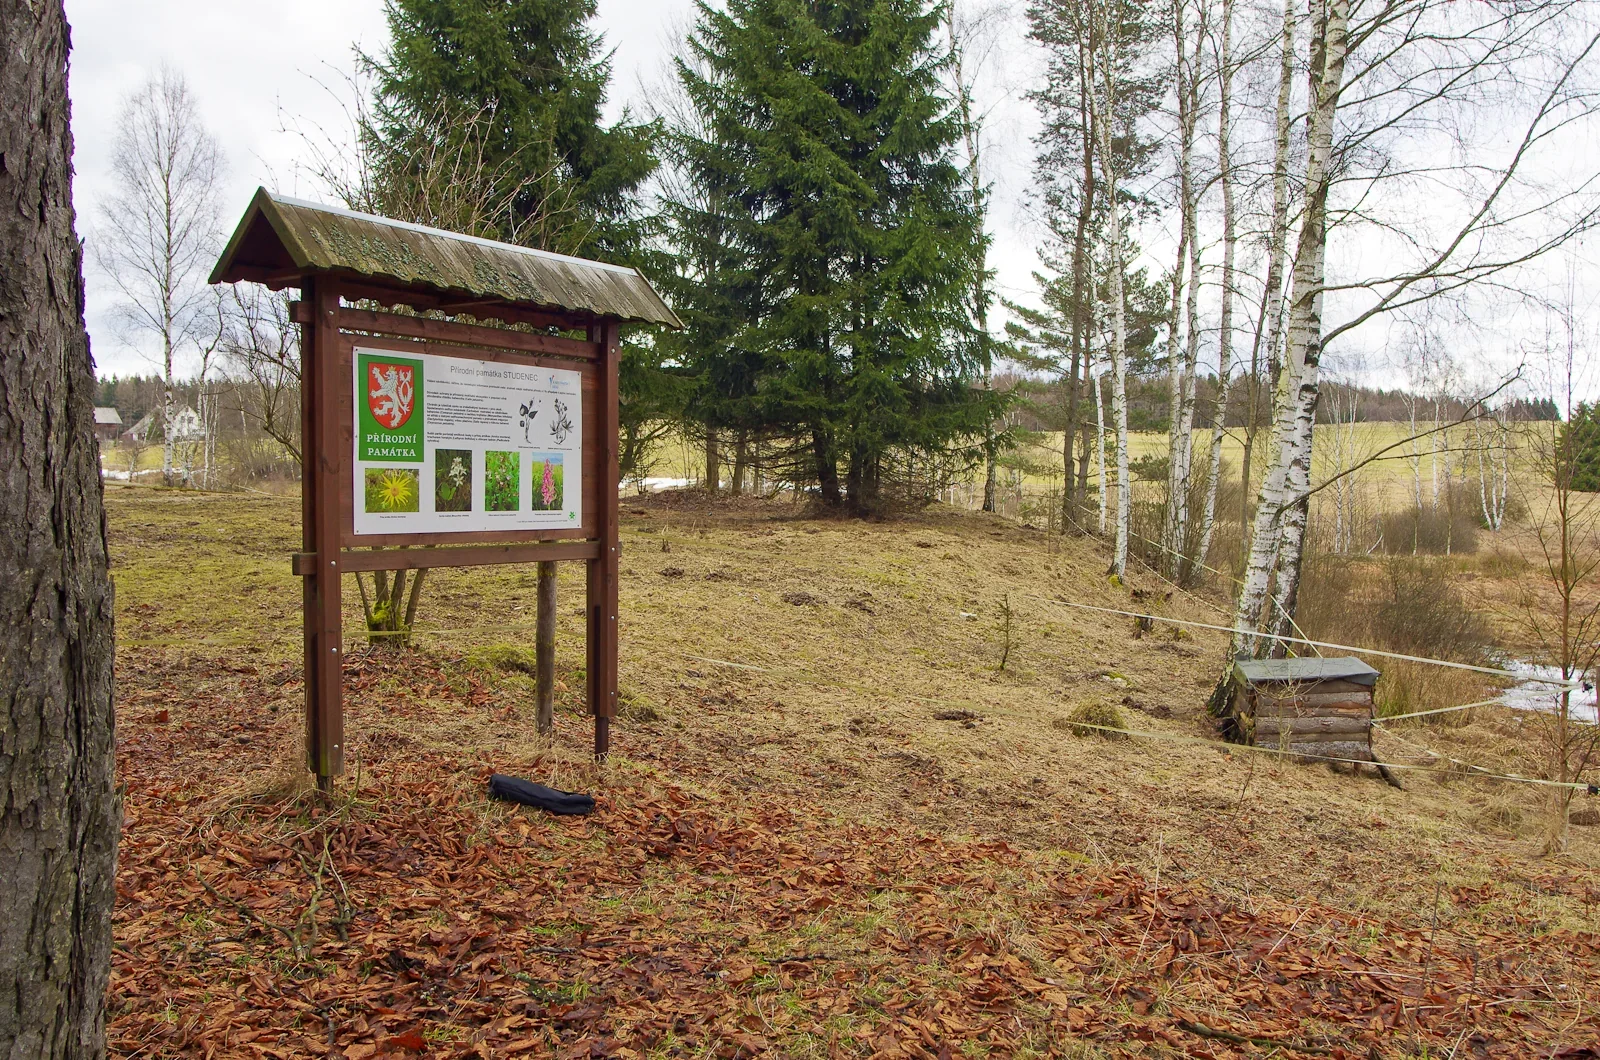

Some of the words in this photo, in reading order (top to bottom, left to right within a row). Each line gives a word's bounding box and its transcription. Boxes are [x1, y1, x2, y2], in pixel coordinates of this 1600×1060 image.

[450, 366, 474, 376] Přírodní
[476, 368, 502, 378] památka
[504, 371, 538, 381] STUDENEC
[366, 432, 416, 444] PŘÍRODNÍ
[368, 446, 416, 456] PAMÁTKA
